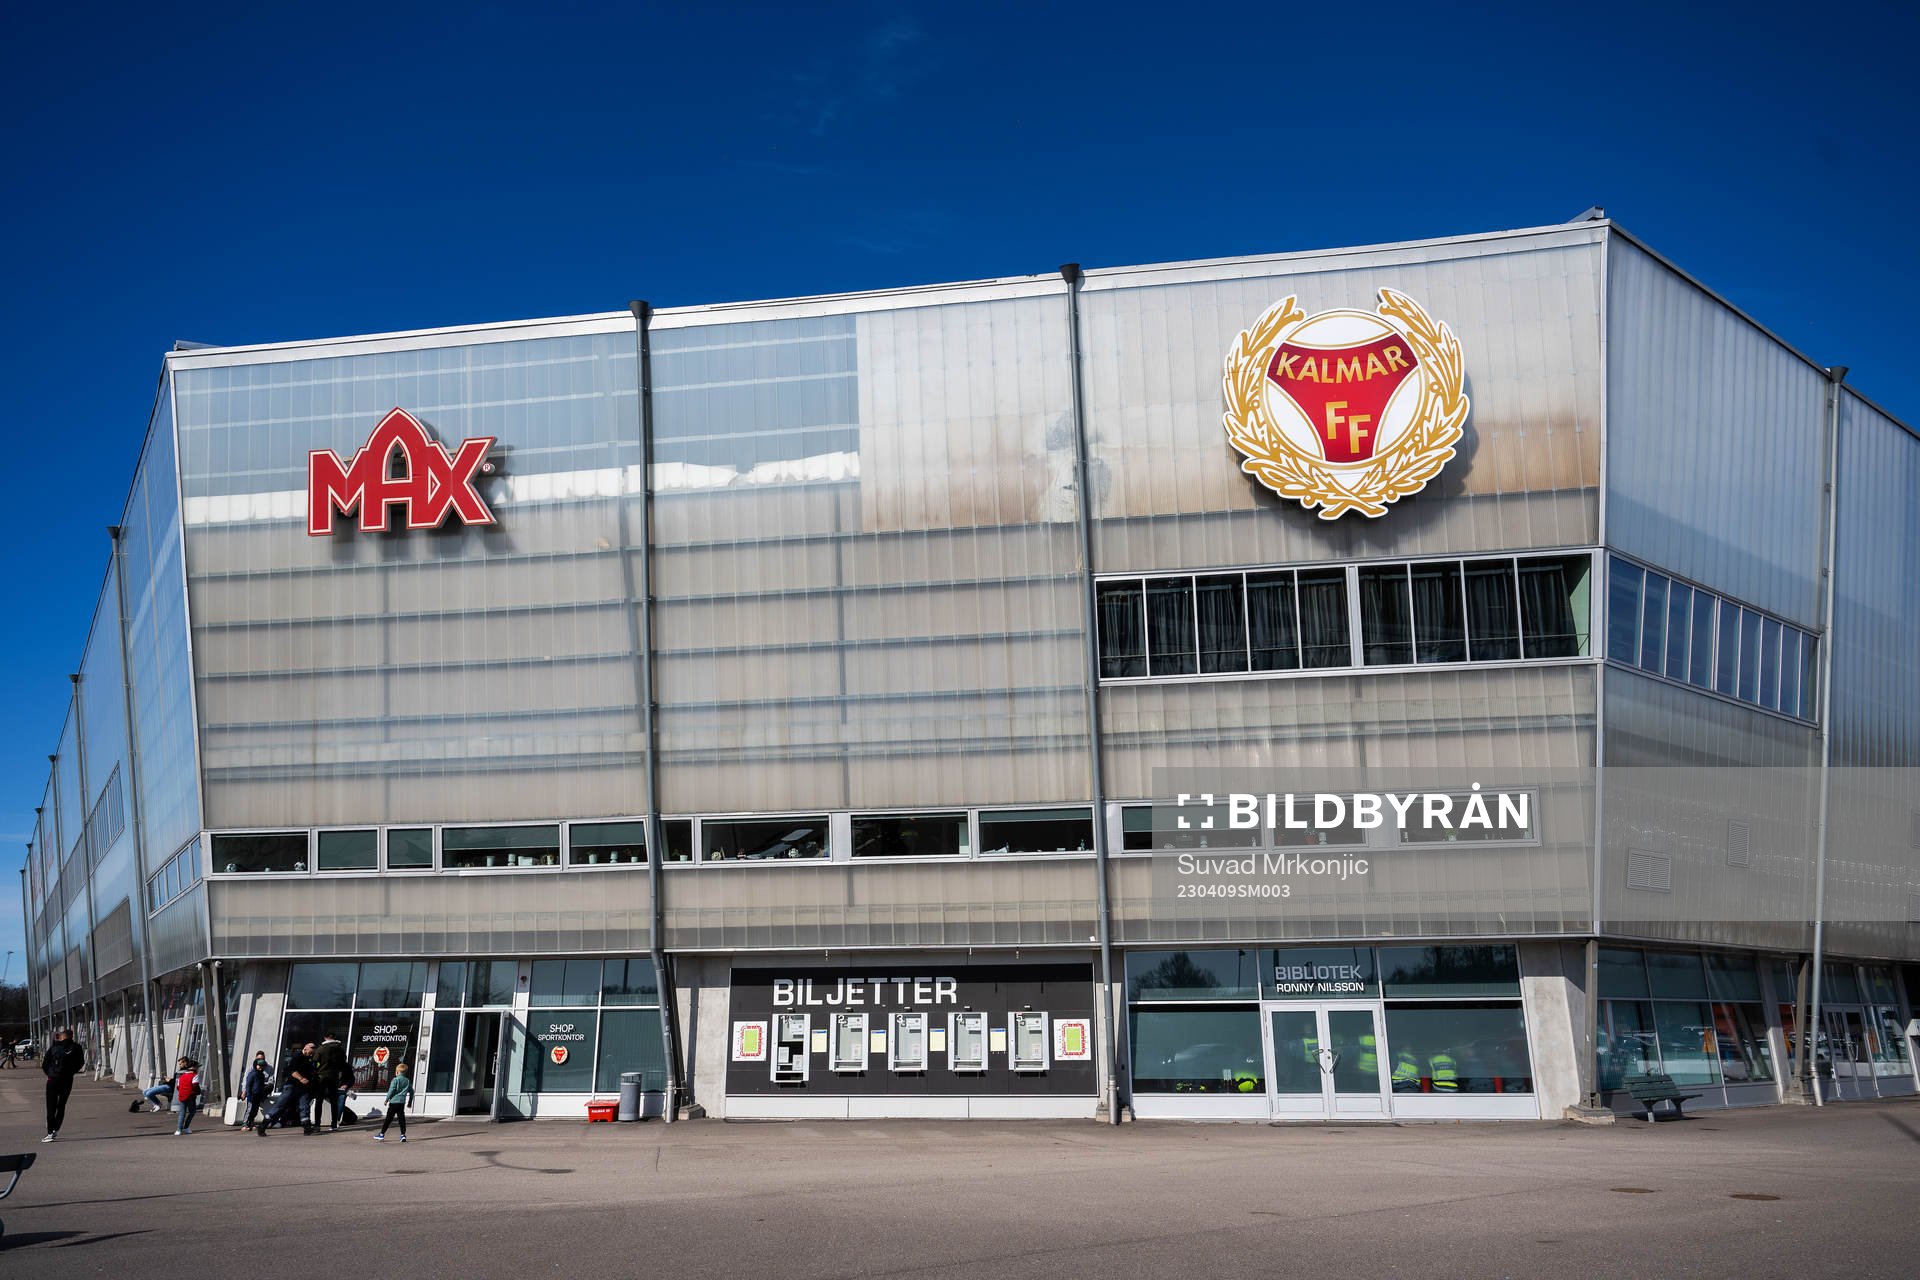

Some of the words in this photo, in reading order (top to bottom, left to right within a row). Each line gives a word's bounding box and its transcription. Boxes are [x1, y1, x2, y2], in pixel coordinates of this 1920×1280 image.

[1275, 344, 1409, 384] KALMAR
[307, 406, 497, 537] MAX
[1275, 965, 1362, 980] BIBLIOTEK
[773, 977, 957, 1006] BILJETTER
[1276, 983, 1314, 992] RONNY
[1318, 982, 1364, 992] NILSSON
[373, 1025, 398, 1034] SHOP
[549, 1024, 574, 1033] SHOP
[537, 1033, 585, 1041] SPORTKONTOR
